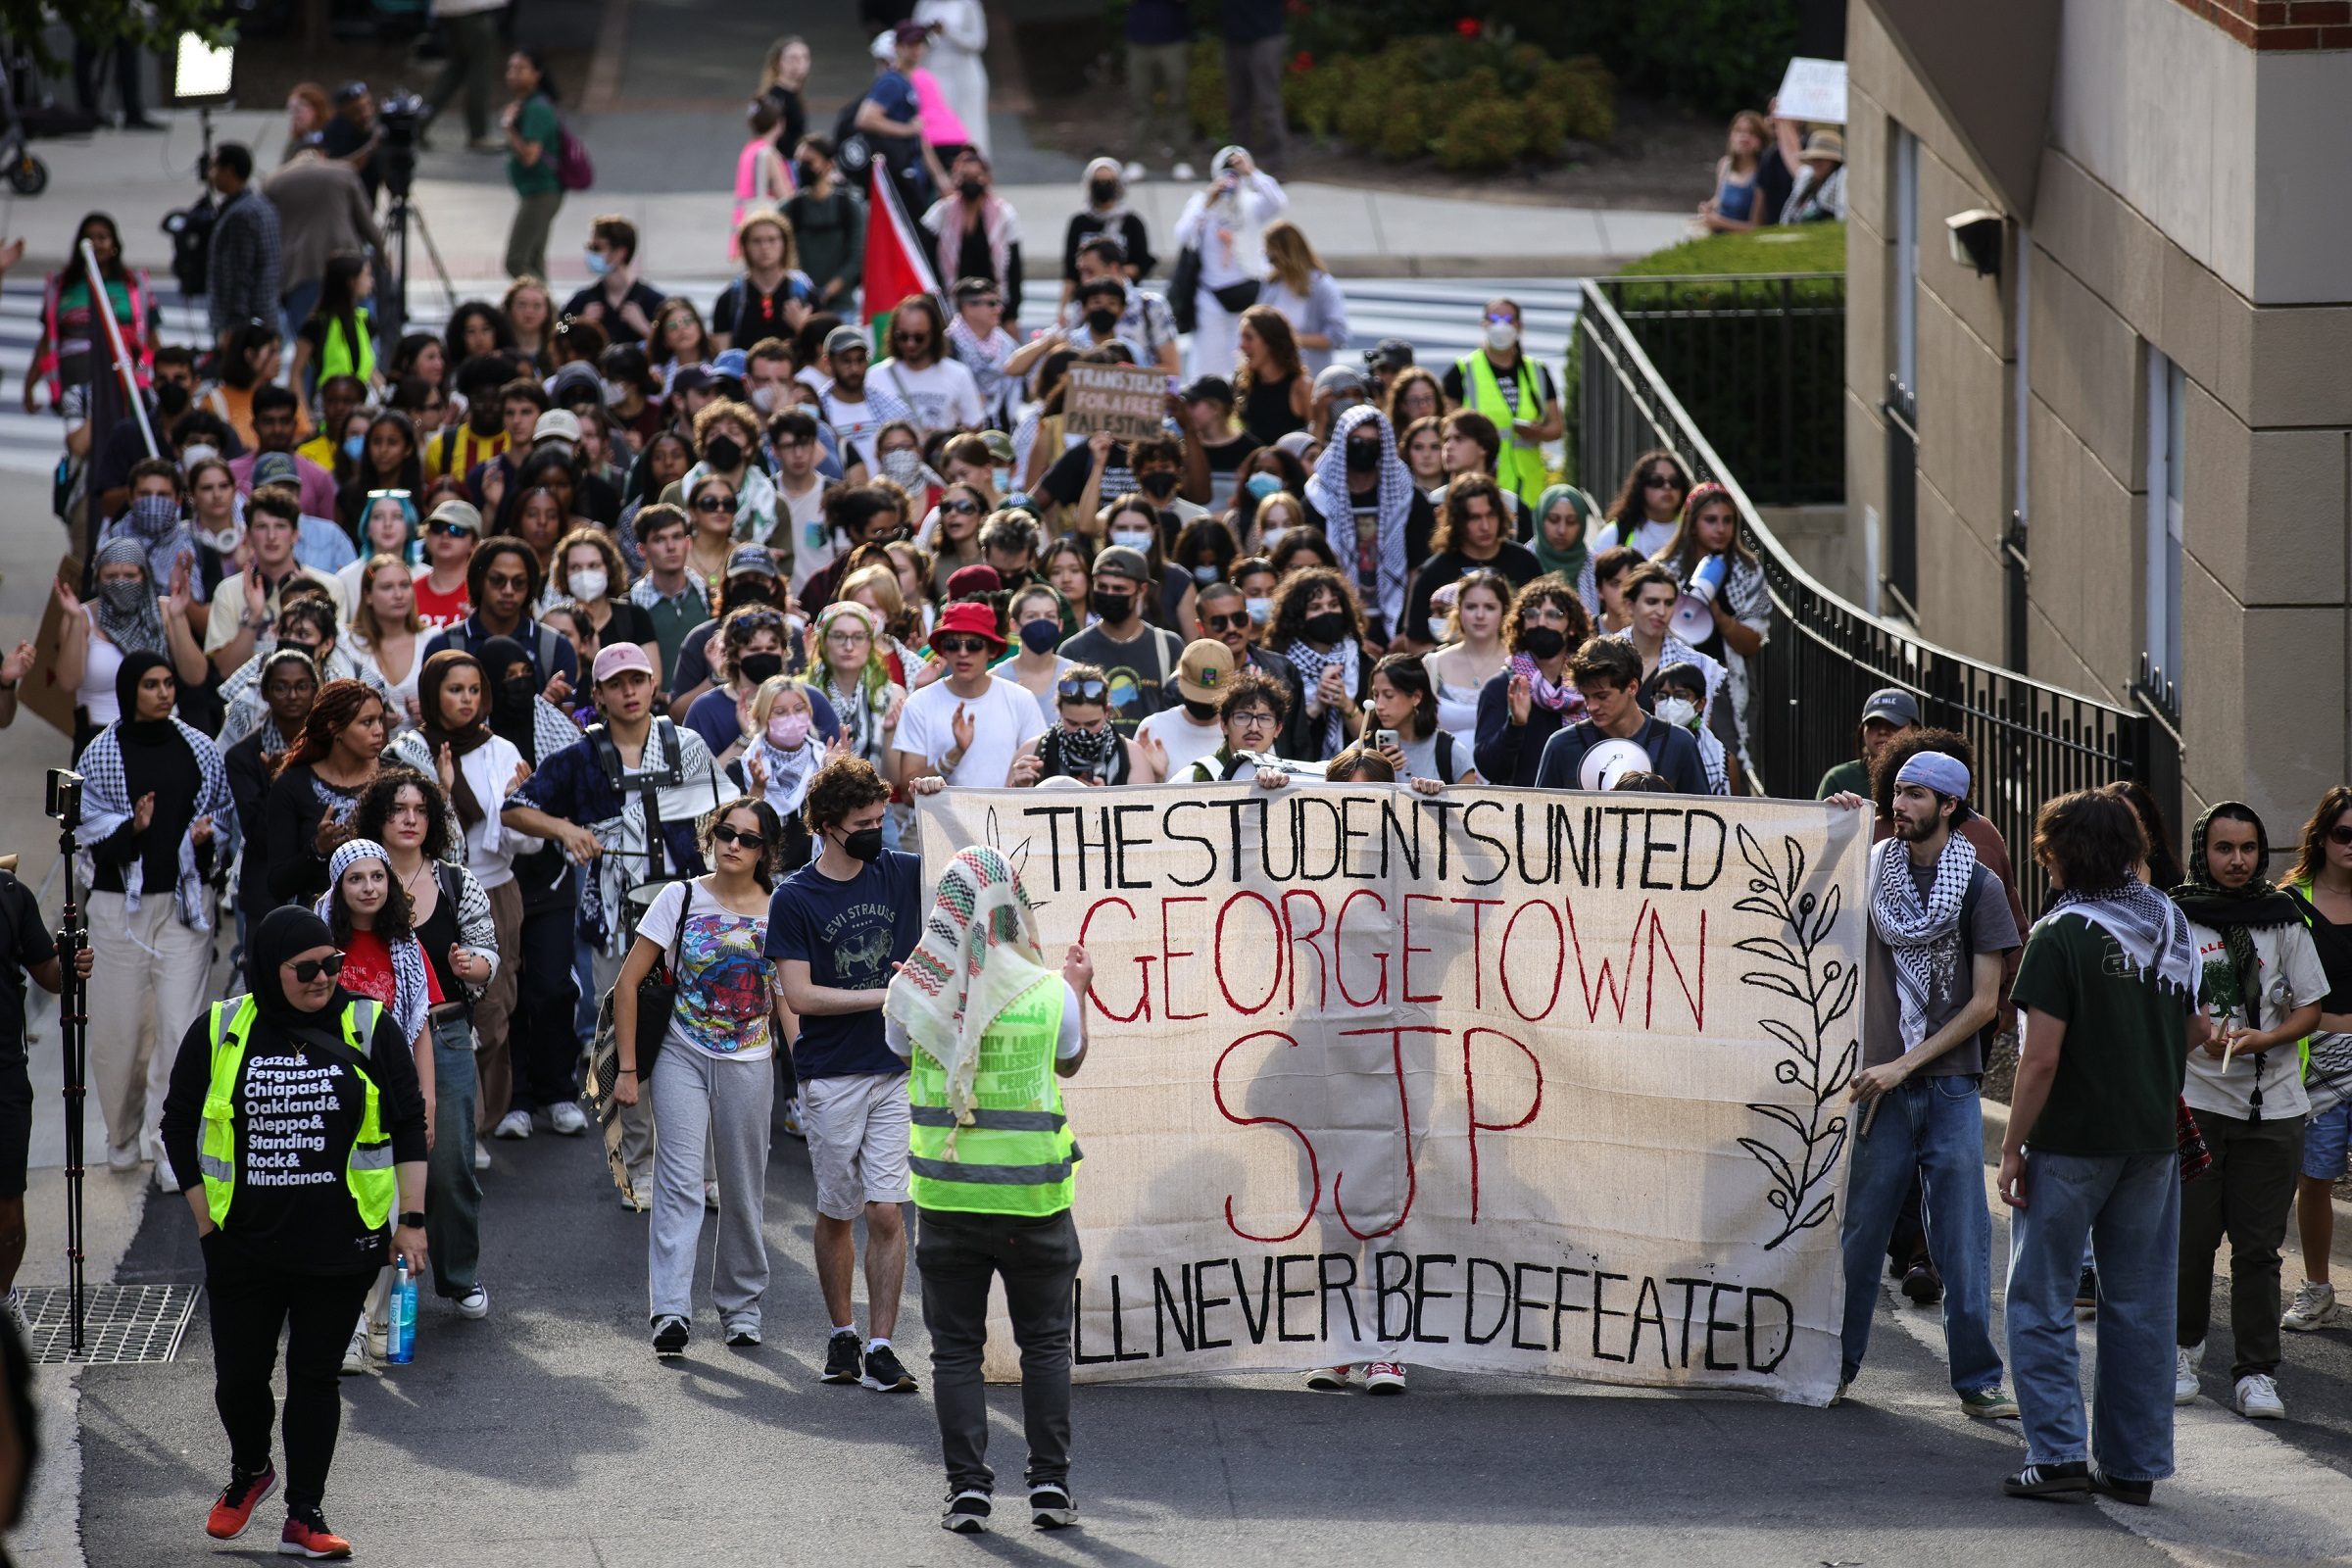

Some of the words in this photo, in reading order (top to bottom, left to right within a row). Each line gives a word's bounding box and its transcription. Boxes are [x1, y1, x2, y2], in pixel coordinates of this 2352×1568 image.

[1069, 368, 1126, 389] TRANS
[1076, 391, 1109, 410] FOR
[1110, 394, 1122, 412] A
[1123, 395, 1160, 416] FREE
[1023, 805, 1153, 892] THE
[1162, 797, 1510, 886] STUDENTS
[1515, 802, 1727, 892] UNITED
[820, 913, 847, 943] LEVI
[847, 904, 896, 923] STRAUSS
[1077, 889, 1705, 1032] GEORGETOWN
[249, 1054, 309, 1067] Gaza&
[246, 1064, 344, 1083] Ferguson&
[244, 1078, 334, 1098] Chiapas&
[245, 1095, 340, 1115] Oakland&
[247, 1114, 325, 1135] Aleppo&
[1212, 1026, 1544, 1243] SJP
[248, 1133, 325, 1152] Standing
[247, 1152, 300, 1168] Rock&
[247, 1169, 336, 1186] Mindanao.
[1152, 1251, 1361, 1358] NEVER
[1375, 1250, 1456, 1344] BE
[1464, 1257, 1793, 1374] DEFEATED
